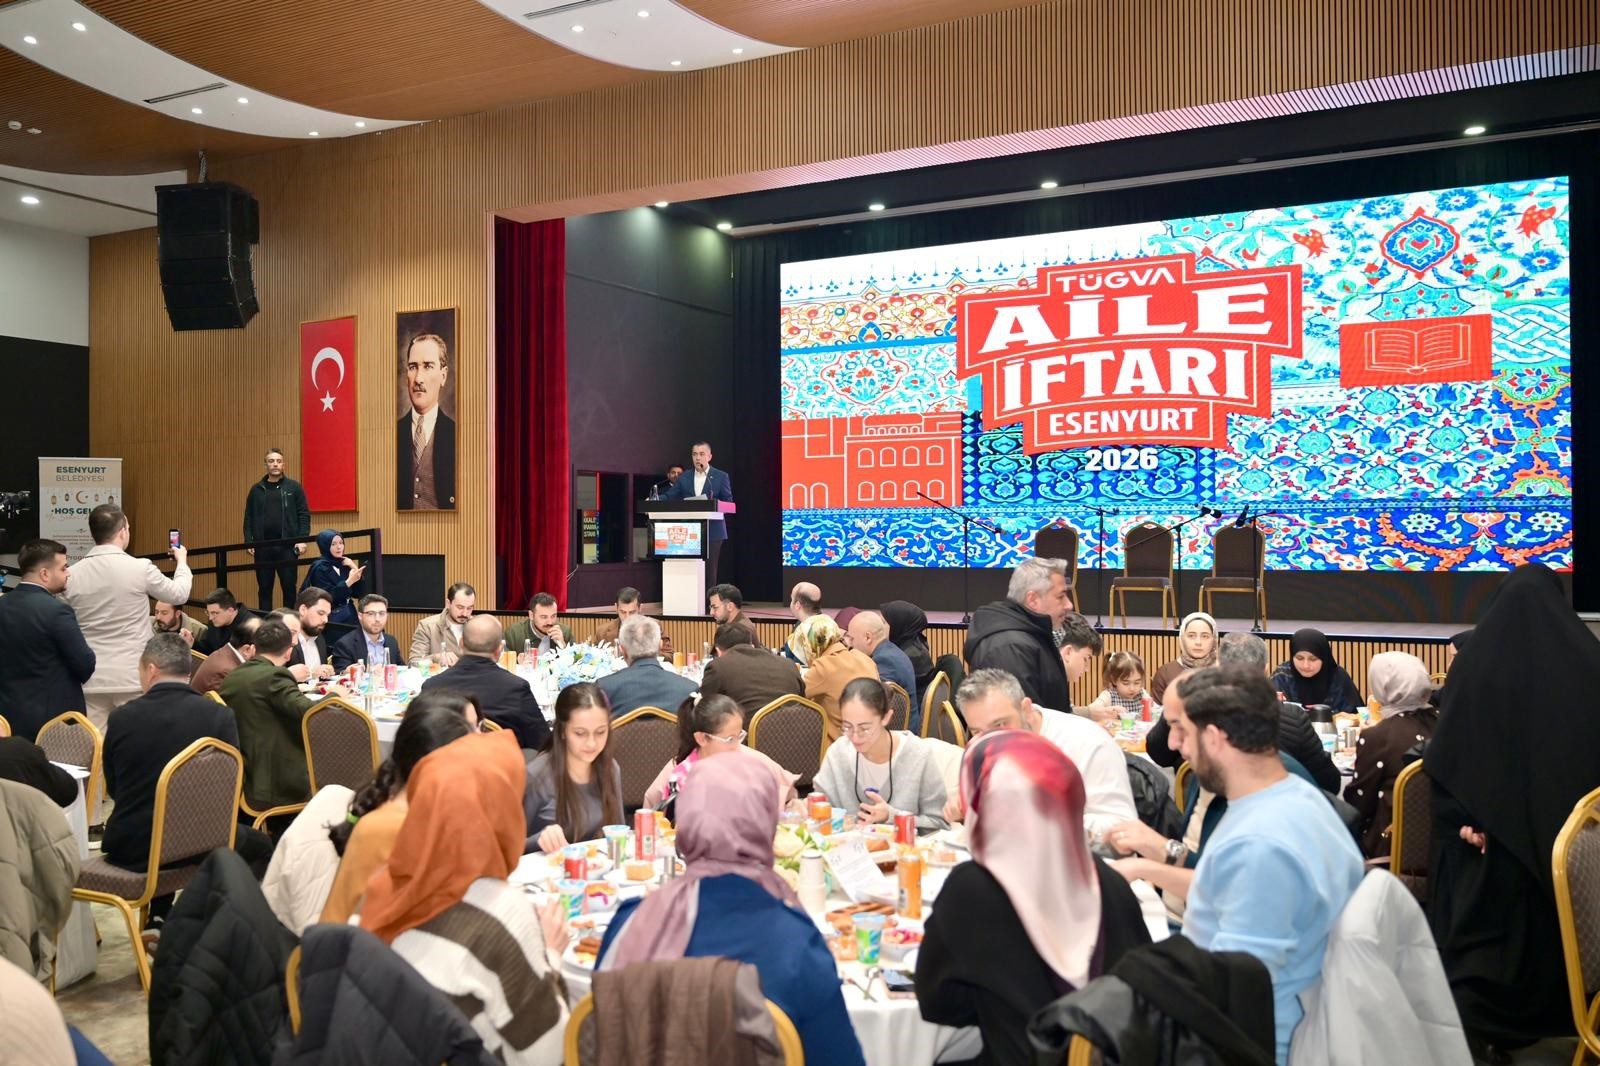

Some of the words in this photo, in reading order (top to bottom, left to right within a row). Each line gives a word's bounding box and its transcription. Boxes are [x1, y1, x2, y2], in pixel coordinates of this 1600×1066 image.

[1056, 267, 1175, 293] TÜGVA
[978, 282, 1273, 354] AİLE
[1001, 347, 1249, 412] İFTARI
[1050, 407, 1198, 436] ESENYURT
[56, 466, 107, 474] ESENYURT
[1084, 448, 1159, 472] 2026
[56, 474, 105, 482] BELEDİYESİ
[54, 507, 74, 516] HOŞ
